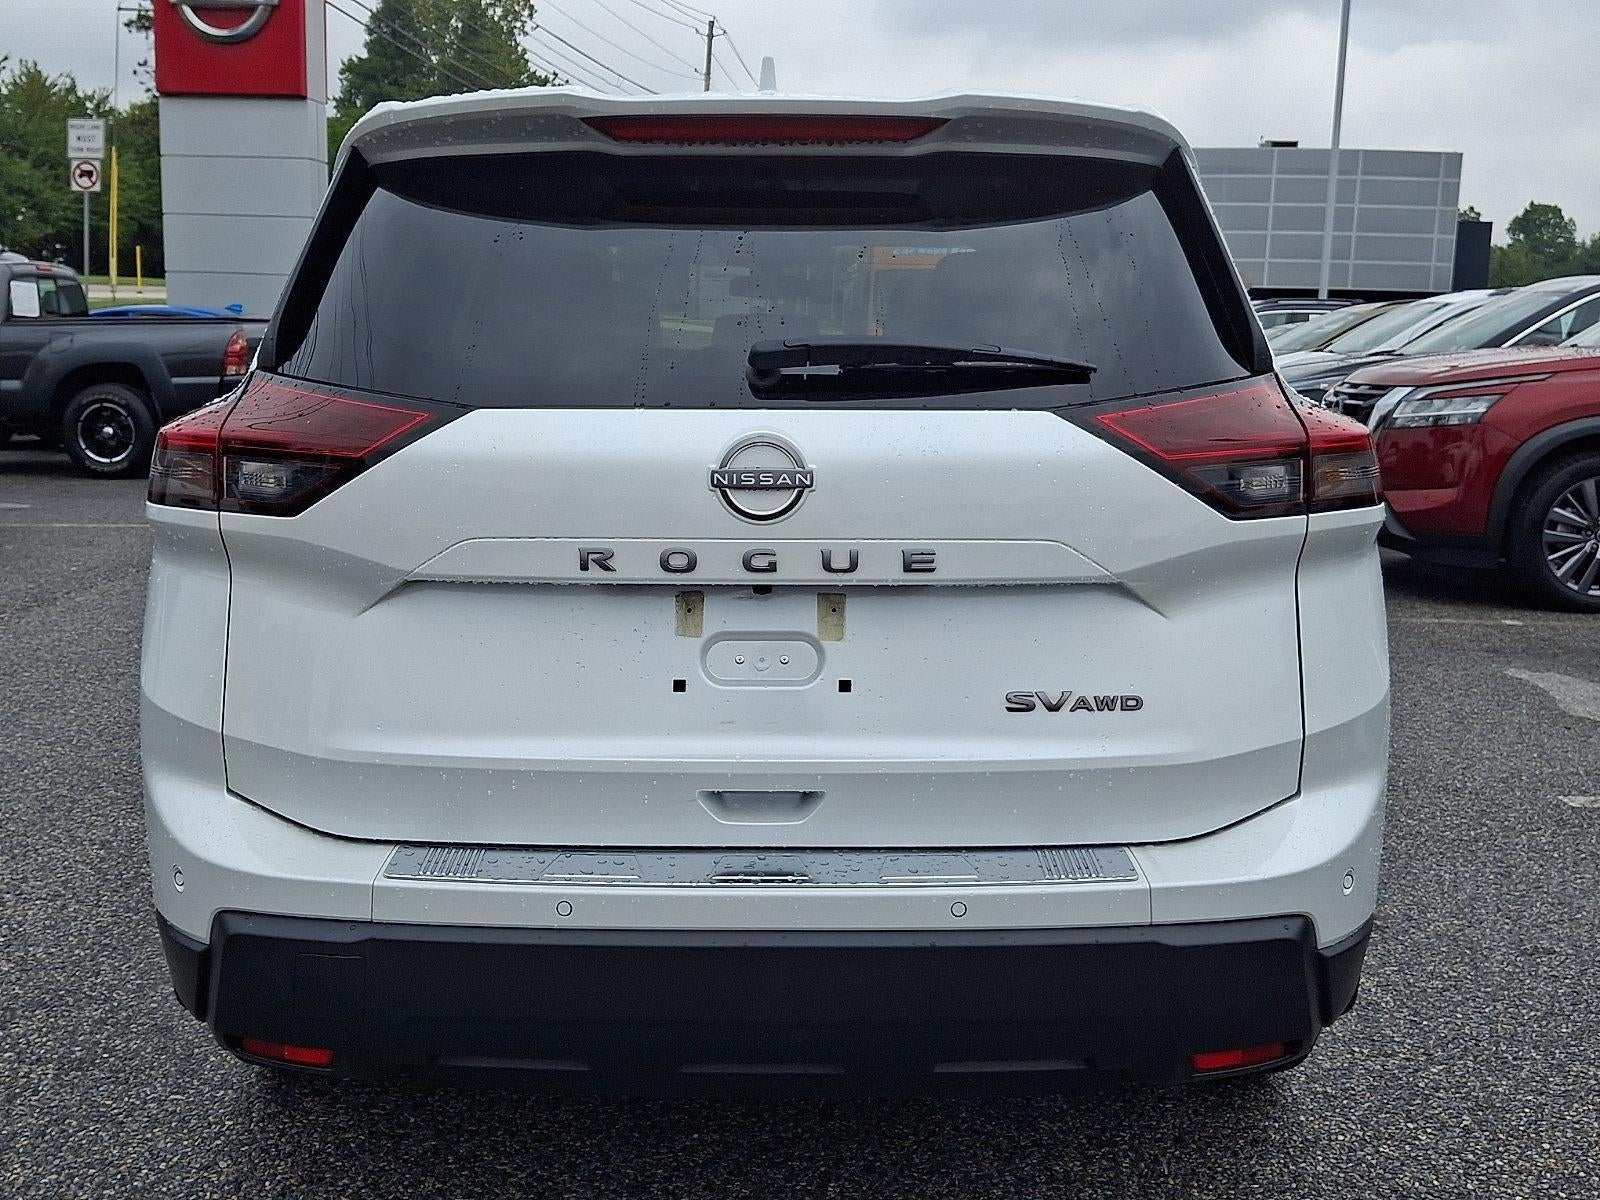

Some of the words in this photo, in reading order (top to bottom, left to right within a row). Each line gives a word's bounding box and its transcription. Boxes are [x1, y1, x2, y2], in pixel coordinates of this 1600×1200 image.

[76, 135, 96, 144] MUST
[714, 473, 811, 485] NISSAN
[578, 548, 936, 573] ROGUE
[1005, 691, 1073, 713] SV
[1069, 695, 1144, 713] AWD
